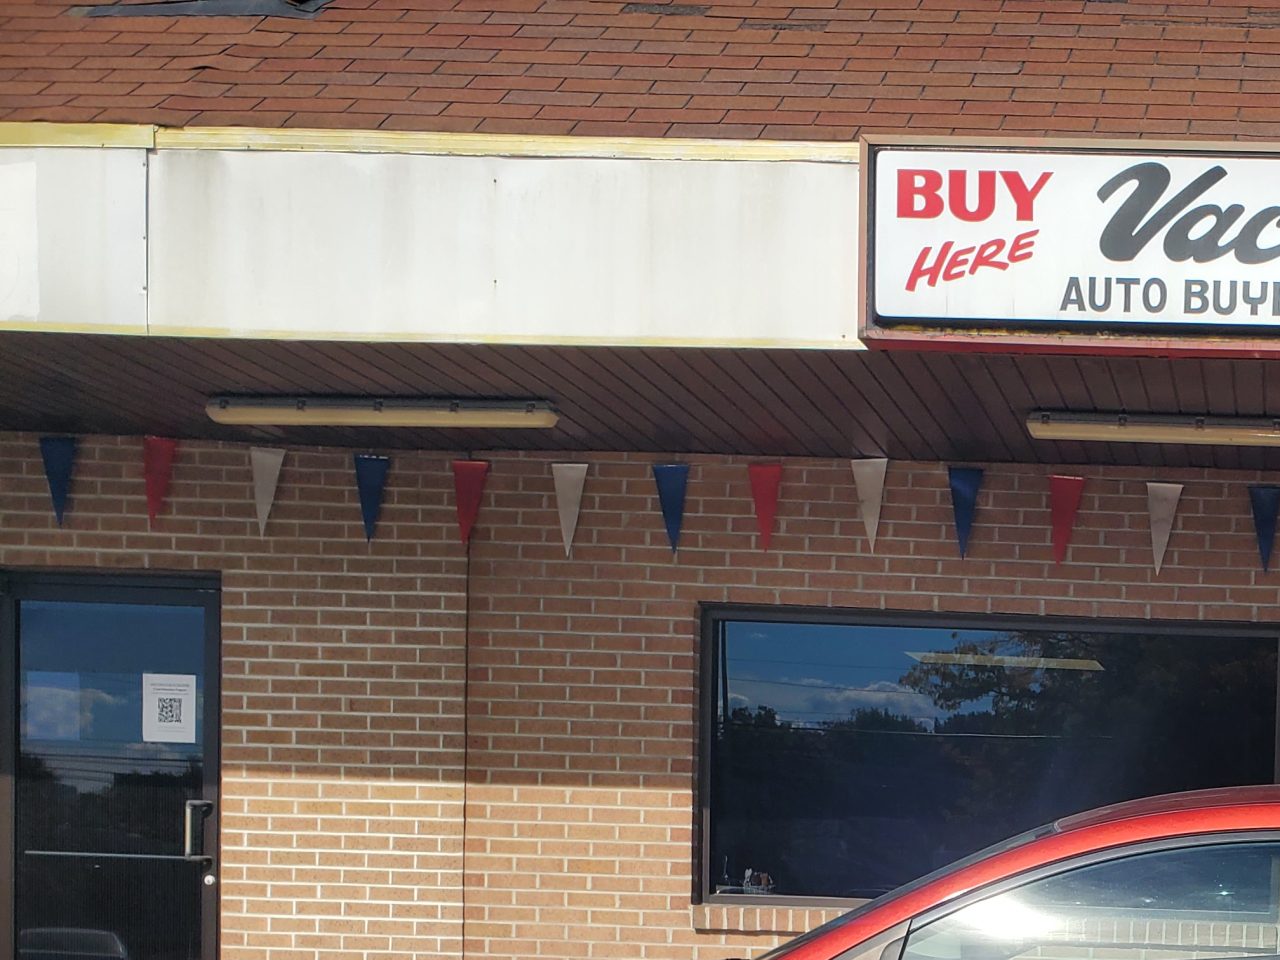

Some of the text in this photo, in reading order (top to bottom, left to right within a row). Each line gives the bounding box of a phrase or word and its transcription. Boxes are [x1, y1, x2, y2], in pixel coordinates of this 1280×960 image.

[897, 170, 1053, 222] BUY
[906, 230, 1037, 291] HERE
[1060, 276, 1168, 314] AUTO
